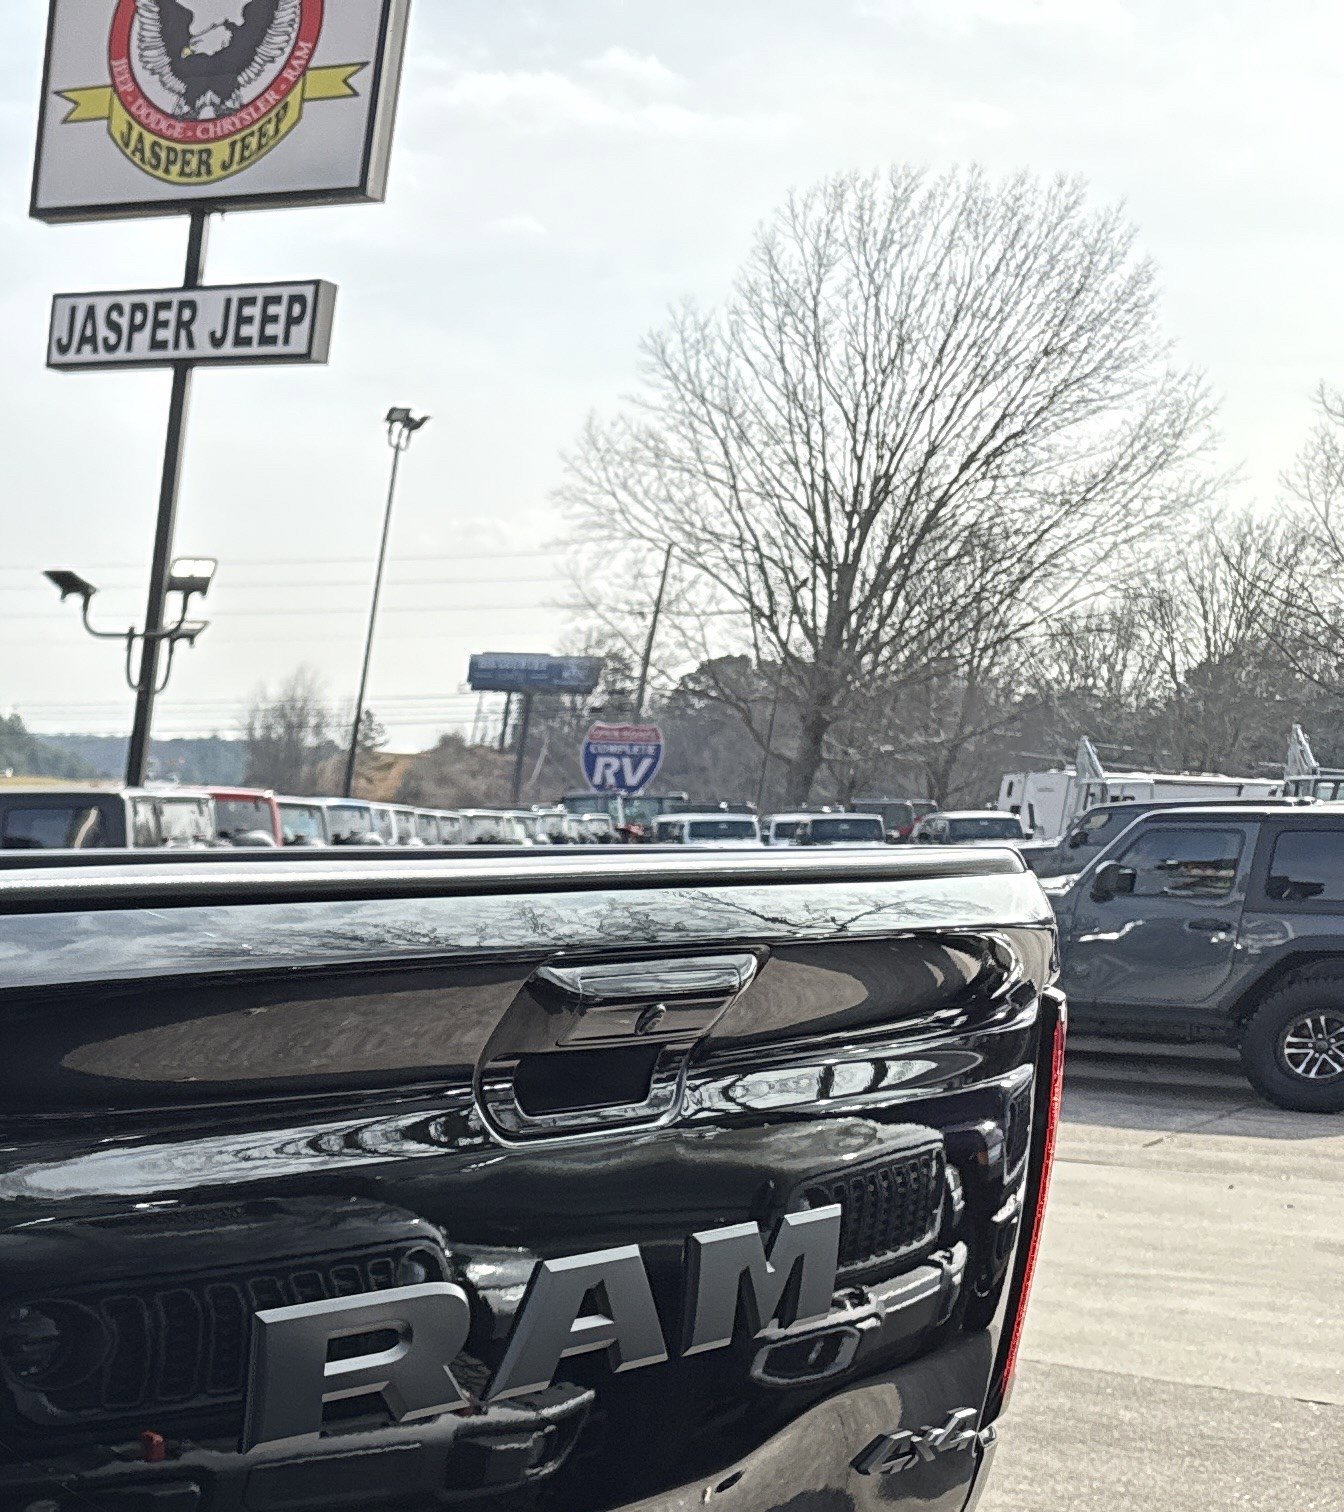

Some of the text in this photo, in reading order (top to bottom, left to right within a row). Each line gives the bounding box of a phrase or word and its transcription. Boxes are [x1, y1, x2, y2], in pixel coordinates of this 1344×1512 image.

[130, 101, 184, 139] DODGE
[195, 91, 280, 139] CHRYSLER
[282, 41, 312, 82] RAM
[120, 101, 290, 178] JASPER JEEP
[56, 293, 308, 357] JASPER JEEP
[592, 756, 653, 787] RV
[240, 1202, 842, 1454] RAM
